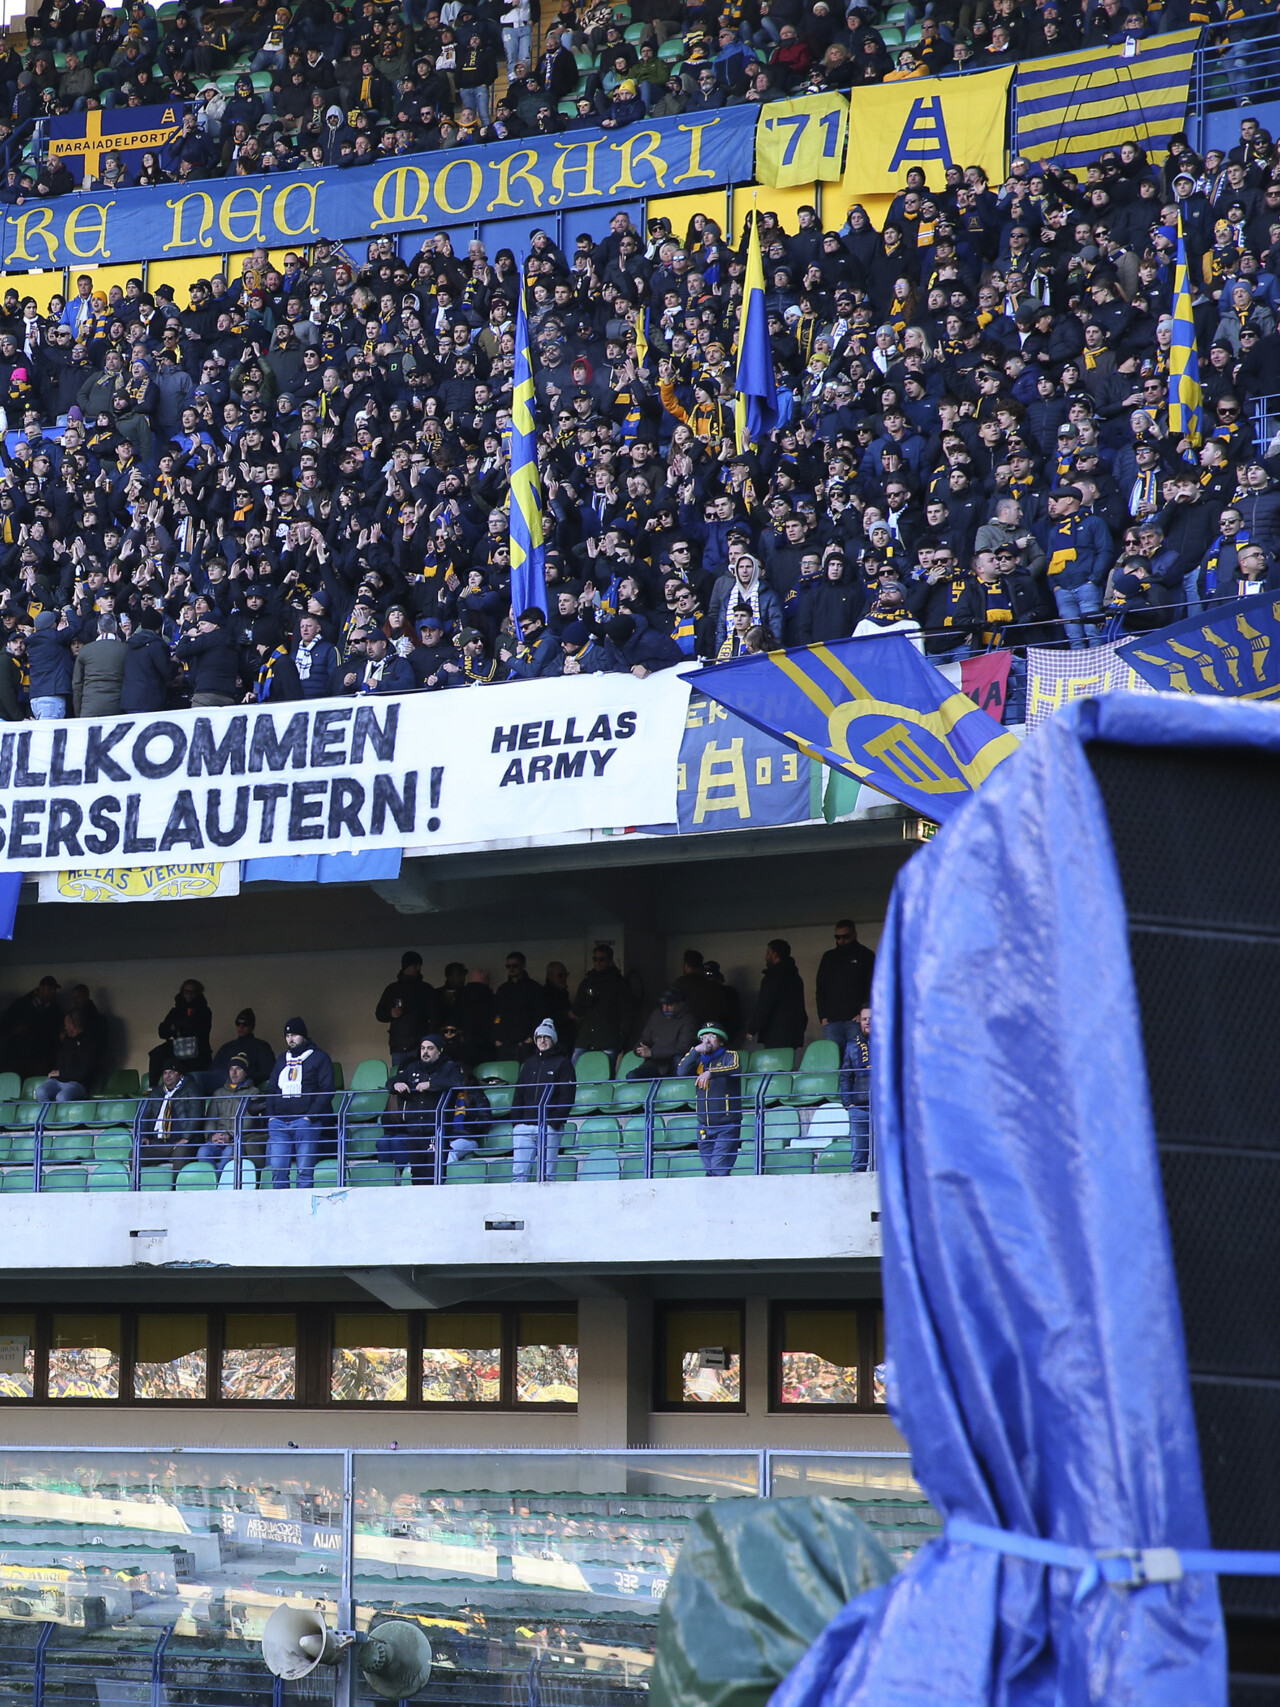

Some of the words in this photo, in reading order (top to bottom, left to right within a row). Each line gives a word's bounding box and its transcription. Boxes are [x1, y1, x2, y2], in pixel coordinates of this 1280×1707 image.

[370, 117, 720, 229] MORARI
[491, 711, 637, 753] HELLAS
[499, 748, 617, 787] ARMY
[68, 868, 128, 890] HELLAS
[143, 862, 215, 889] VERONA
